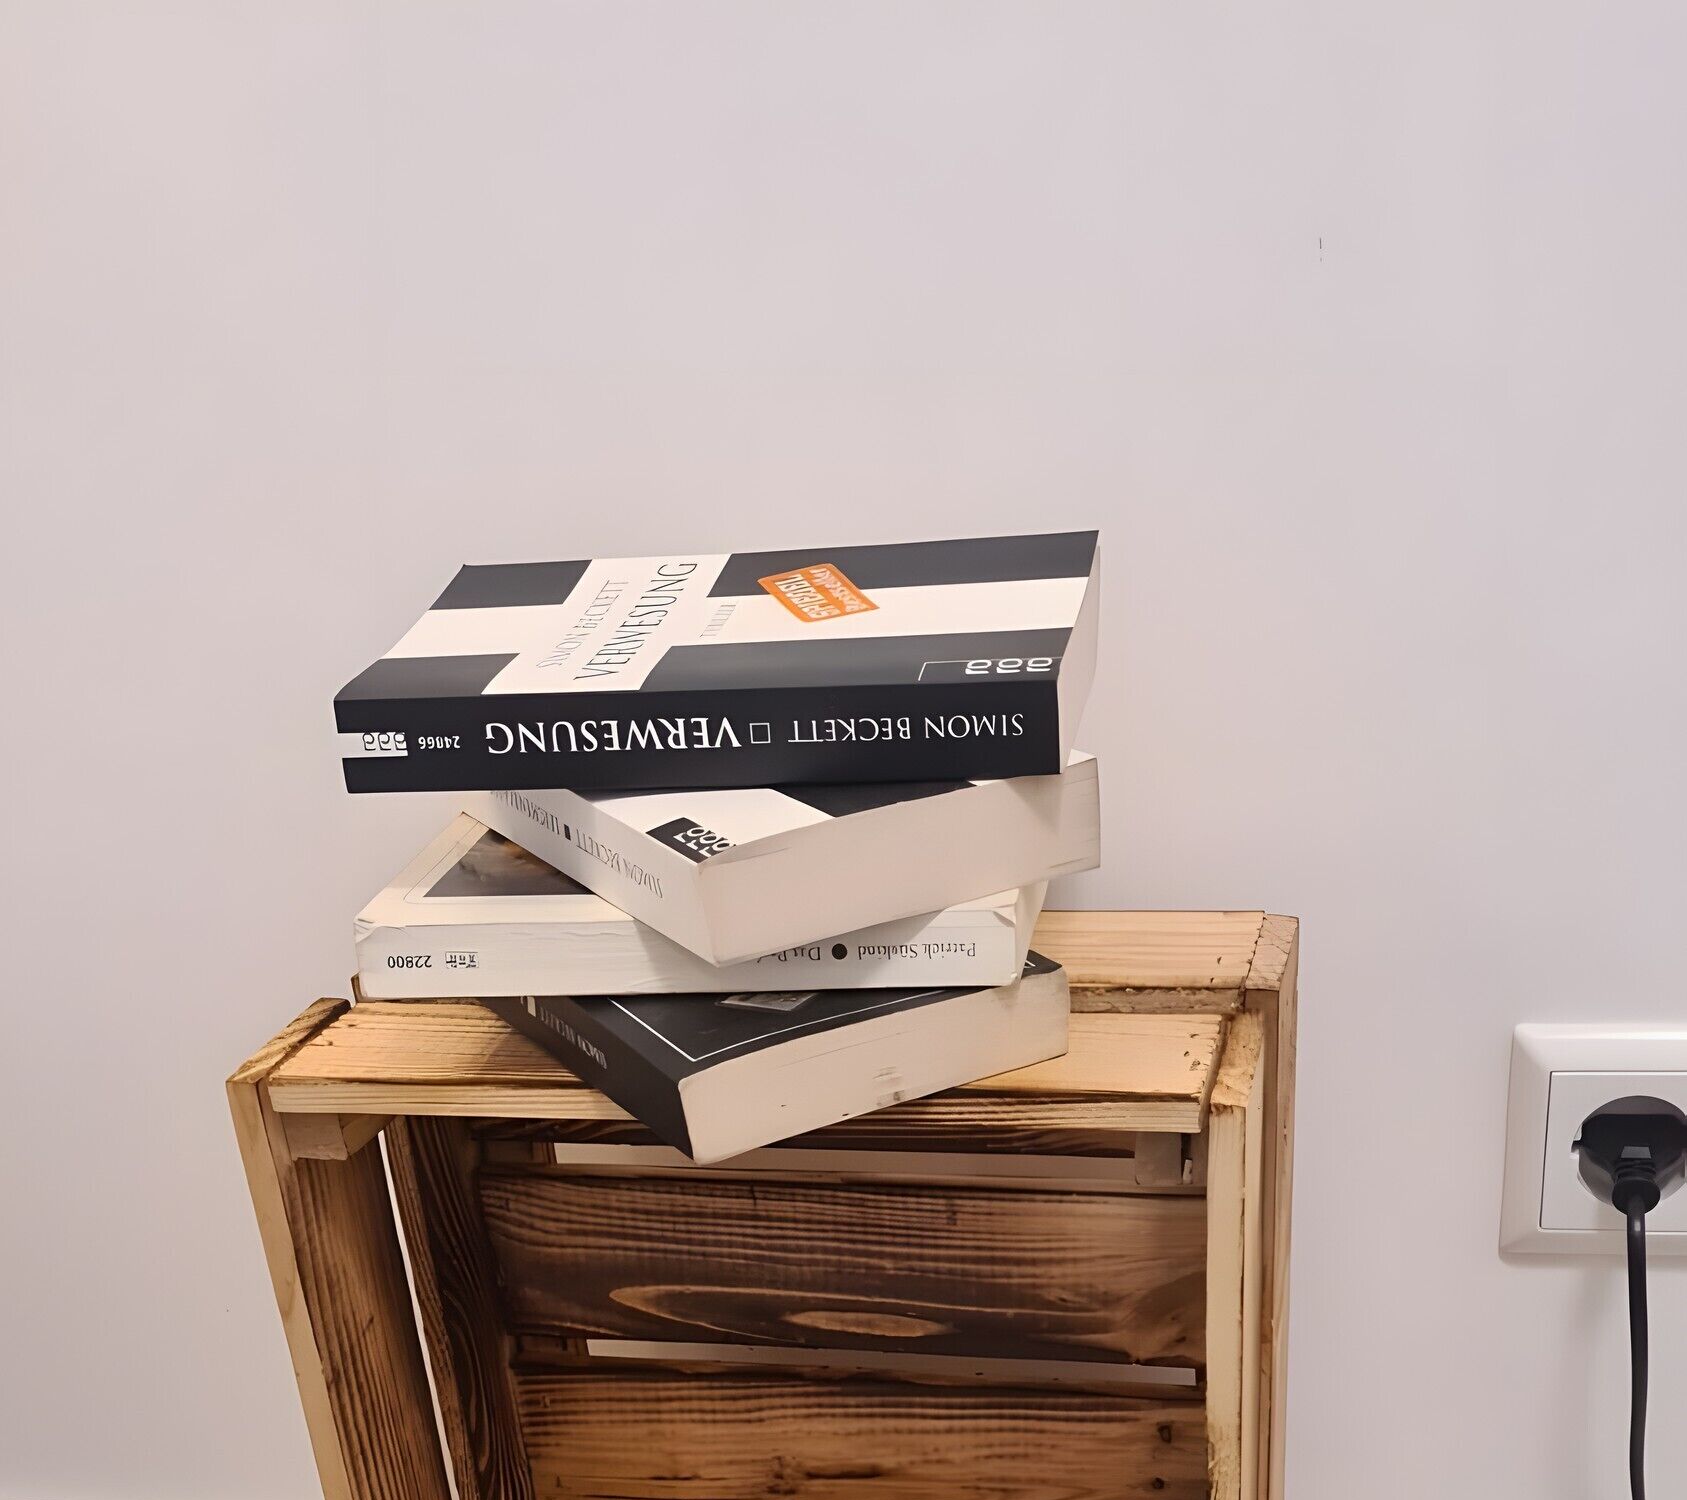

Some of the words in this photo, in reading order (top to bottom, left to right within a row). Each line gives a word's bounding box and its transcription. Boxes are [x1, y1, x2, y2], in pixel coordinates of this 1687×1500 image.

[573, 562, 699, 681] VERWESUNG
[484, 716, 742, 754] VERWESUNG
[787, 716, 911, 743] BECKETT
[924, 712, 1025, 739] SIMON
[417, 734, 461, 750] 24066
[386, 954, 433, 969] 22800
